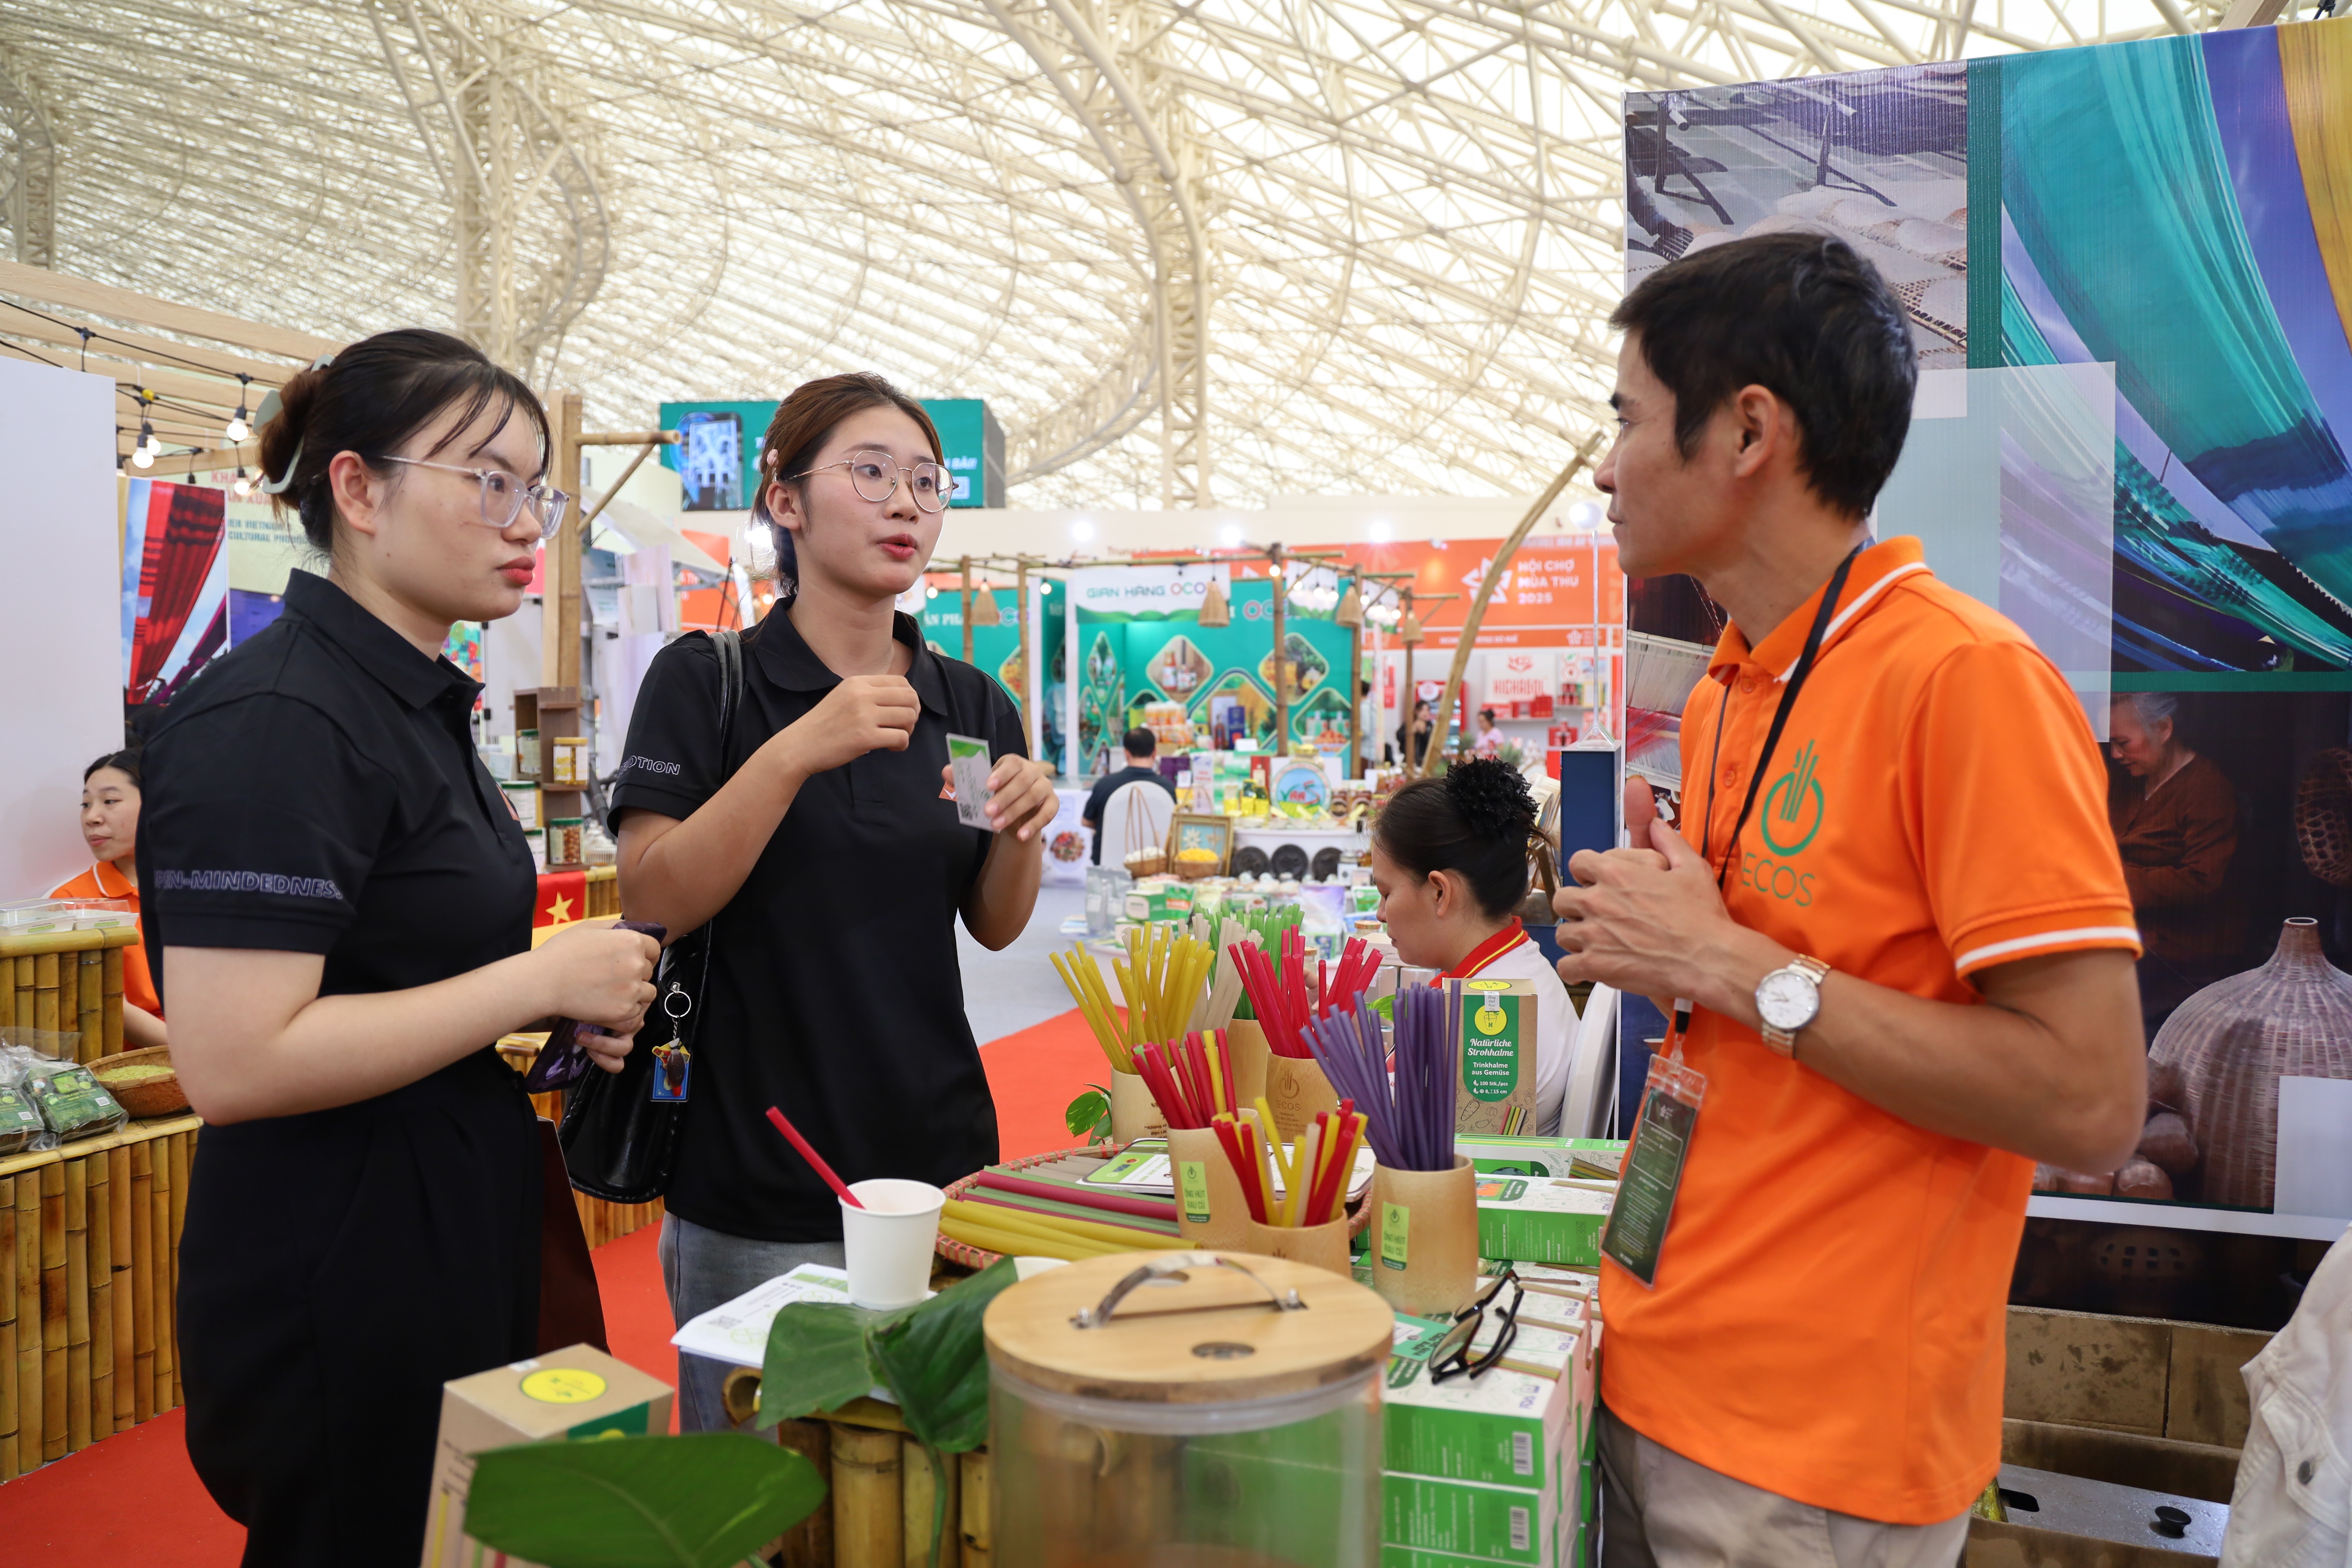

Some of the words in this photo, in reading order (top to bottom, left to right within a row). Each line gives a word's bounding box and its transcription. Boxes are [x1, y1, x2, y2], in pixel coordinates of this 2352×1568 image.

[1551, 575, 1579, 588] THU
[1170, 582, 1206, 596] OCO
[1517, 592, 1553, 605] 2025
[1743, 852, 1815, 907] ECOS
[1470, 1038, 1512, 1047] Natürliche
[1467, 1048, 1514, 1056] Strohhalme
[1276, 1100, 1300, 1111] ECOS
